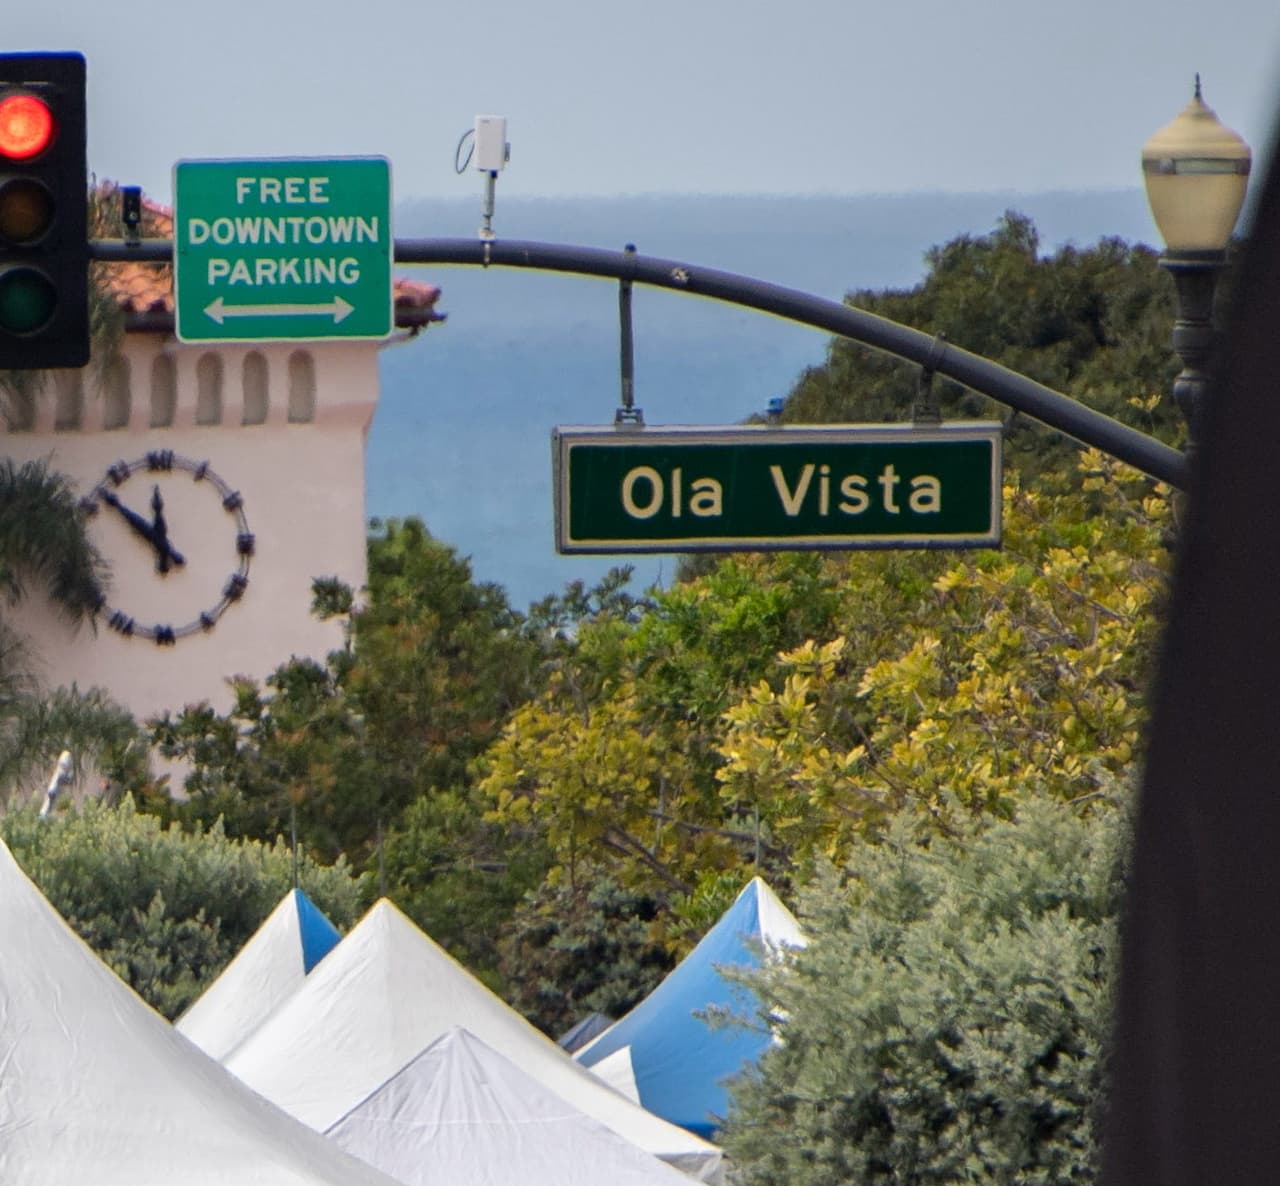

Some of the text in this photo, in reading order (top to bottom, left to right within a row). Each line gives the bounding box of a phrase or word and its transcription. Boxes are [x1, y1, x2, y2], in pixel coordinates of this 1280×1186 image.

[236, 177, 329, 204] FREE
[188, 216, 379, 245] DOWNTOWN
[207, 257, 360, 285] PARKING
[621, 463, 941, 520] Ola Vista
